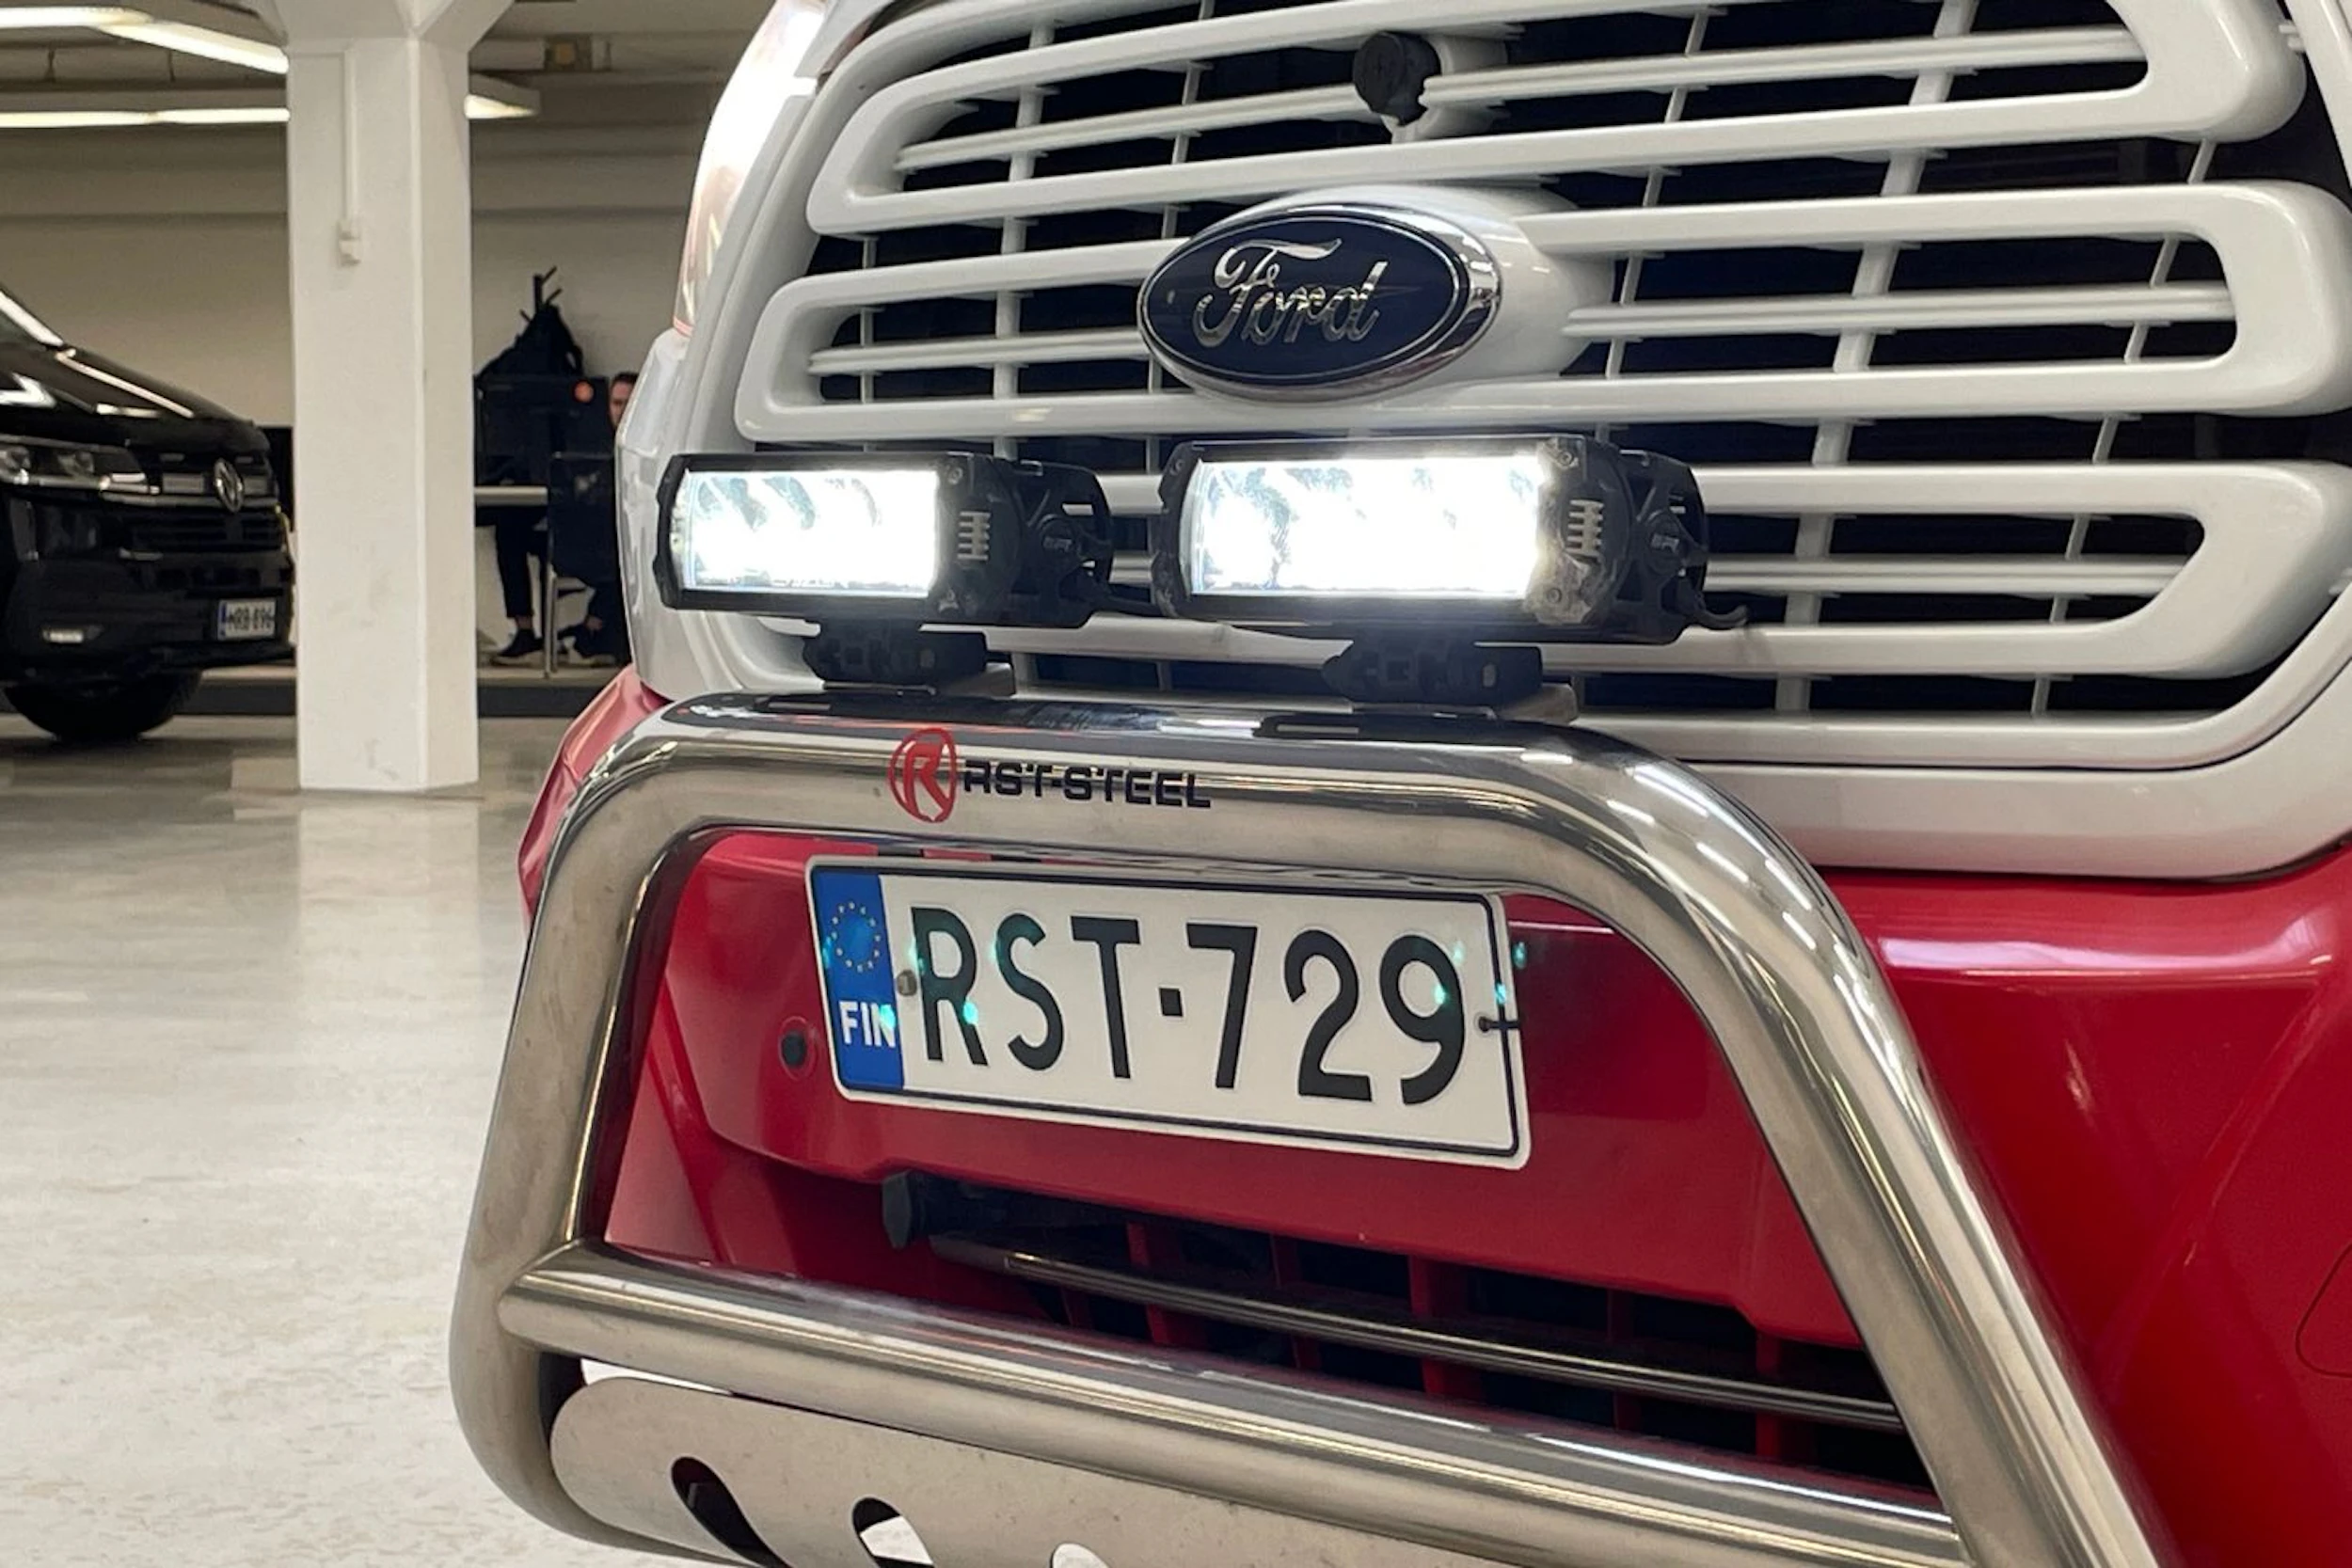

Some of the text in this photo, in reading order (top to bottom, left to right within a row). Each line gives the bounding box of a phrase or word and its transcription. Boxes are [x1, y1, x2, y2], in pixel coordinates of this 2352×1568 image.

[1193, 238, 1389, 347] Ford
[963, 759, 1212, 809] RST-STEEL
[838, 906, 1465, 1106] FIN RST-729
